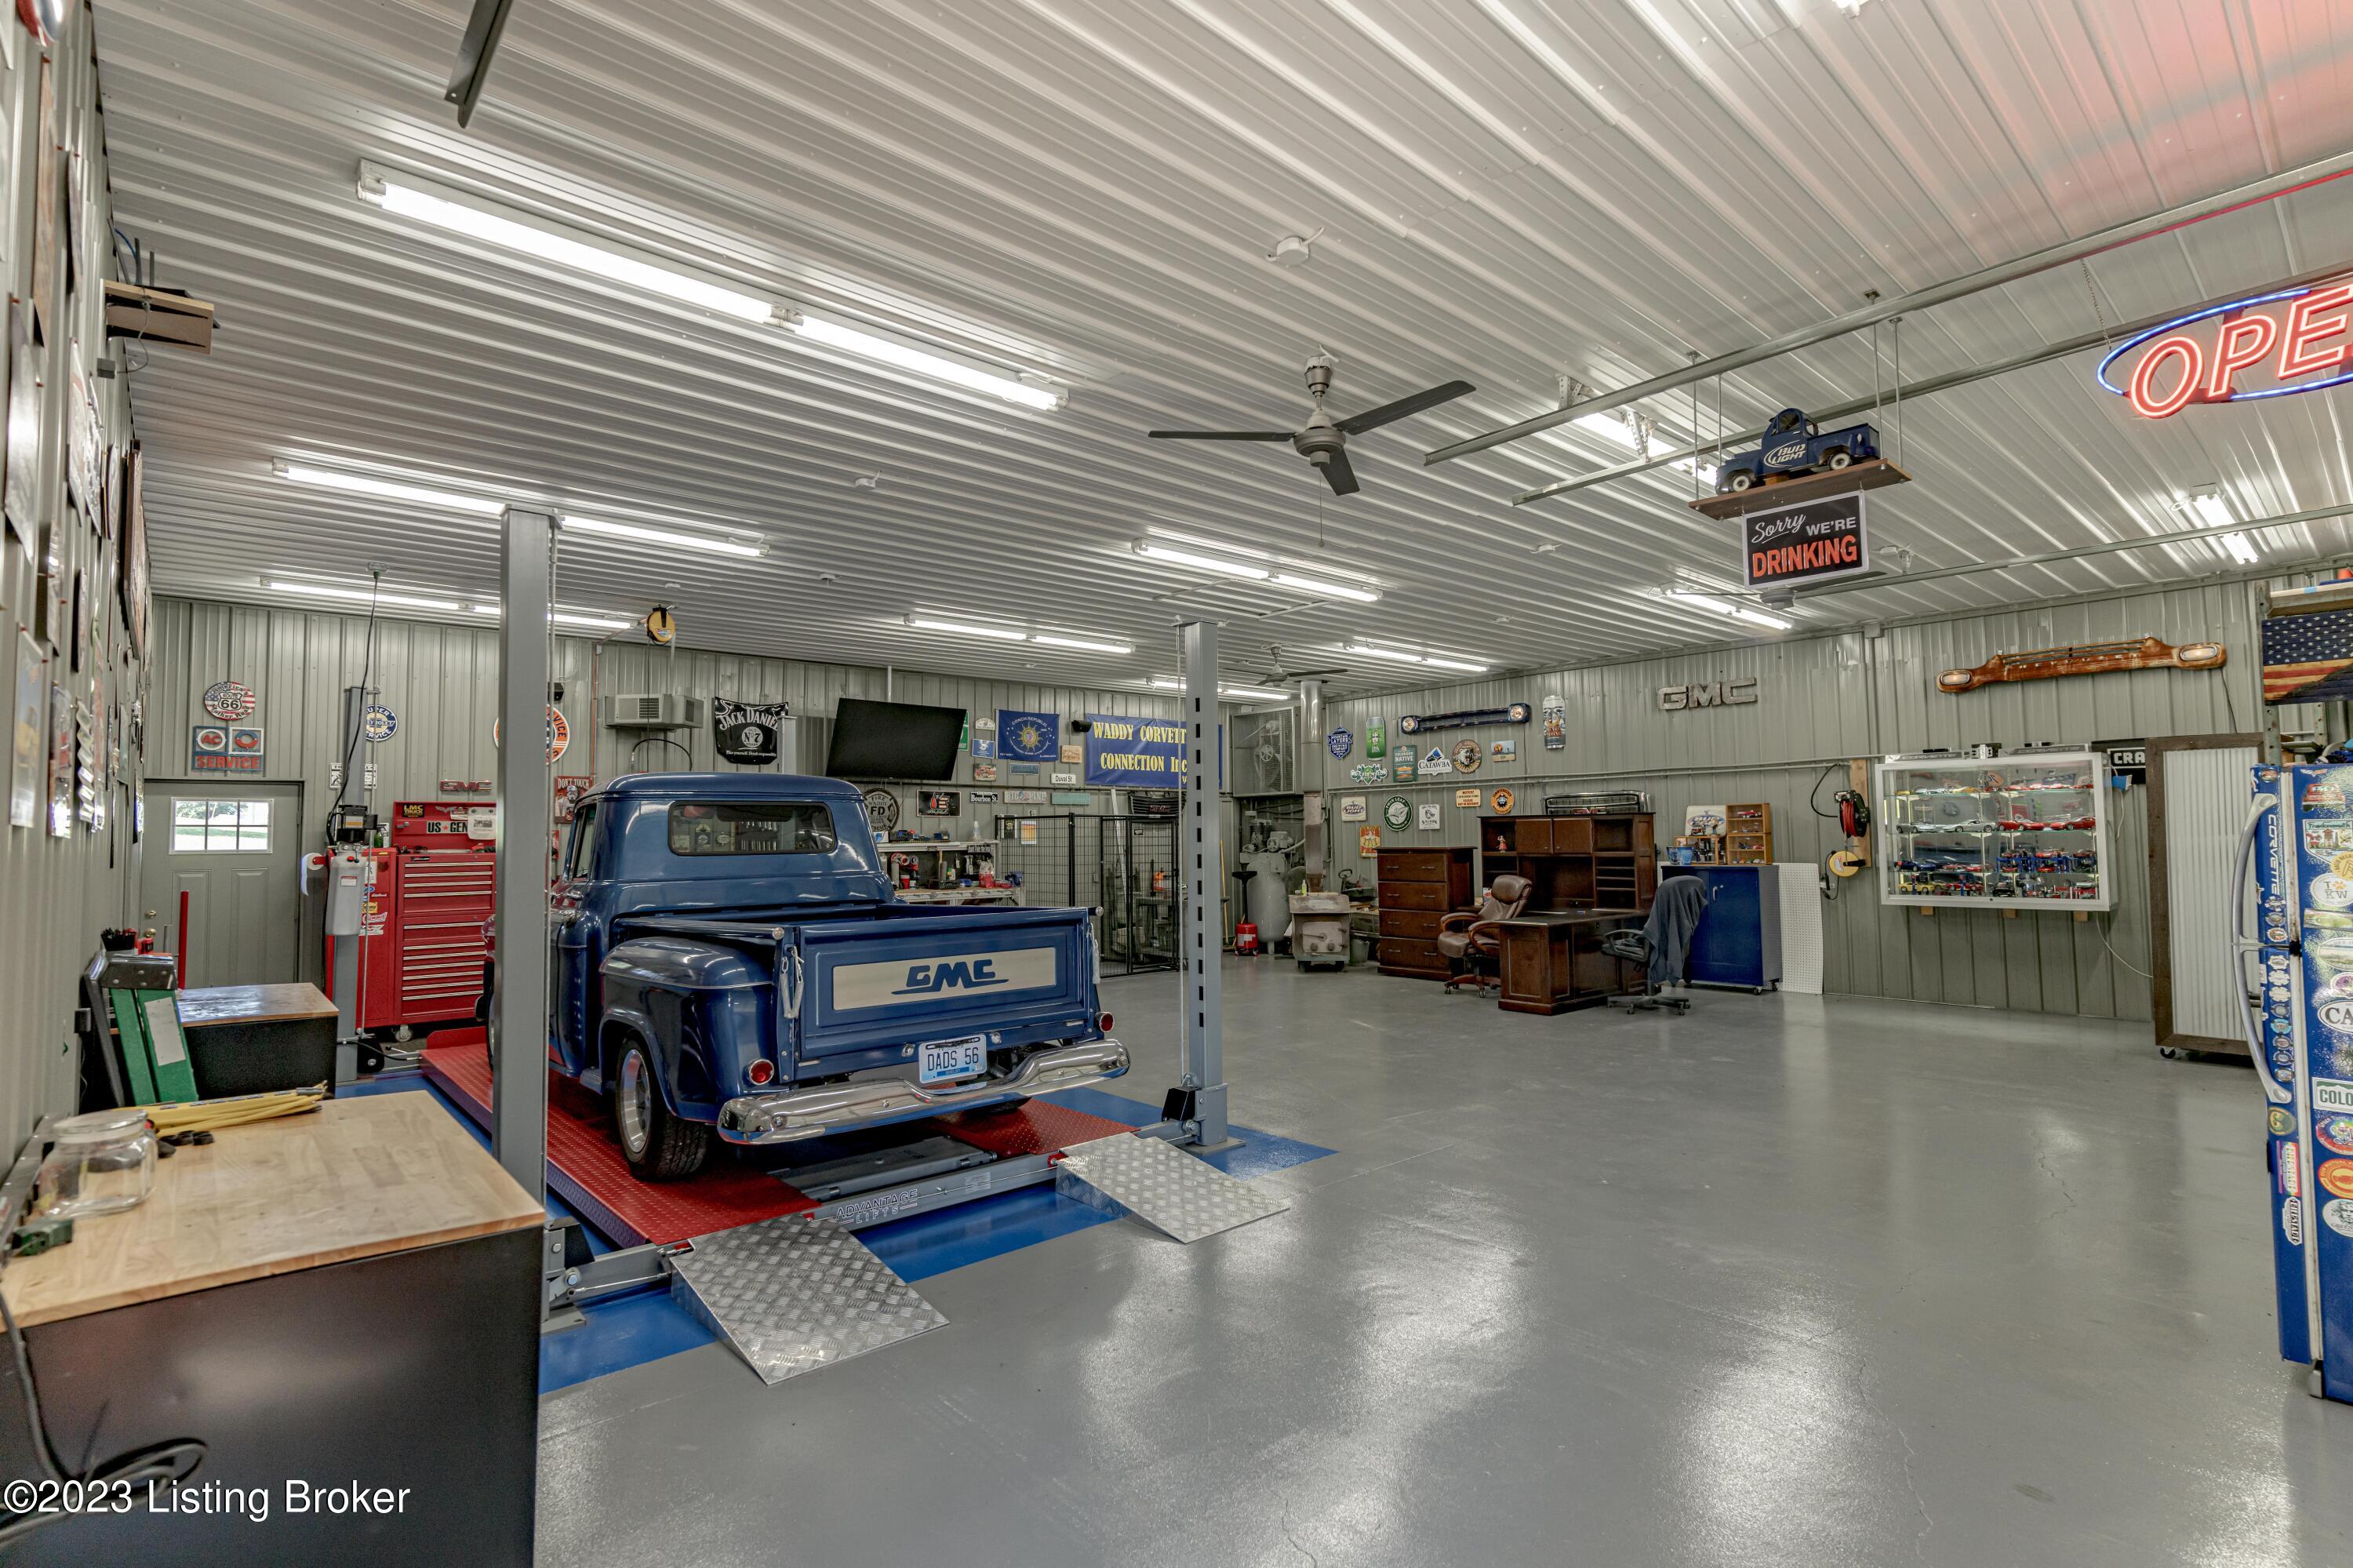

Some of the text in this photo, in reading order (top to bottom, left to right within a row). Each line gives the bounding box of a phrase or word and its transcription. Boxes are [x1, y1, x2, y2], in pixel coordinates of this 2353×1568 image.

[1778, 443, 1806, 456] BUD
[1771, 450, 1806, 464] LIGHT
[1751, 514, 1857, 544] Sorry WE'RE
[1752, 534, 1857, 578] DRINKING
[1657, 677, 1758, 710] GMC
[220, 699, 239, 709] 66
[235, 705, 250, 718] Road
[719, 711, 746, 730] JACK
[1012, 716, 1048, 727] CONCH REPUBLIC
[201, 734, 223, 744] AC
[1093, 722, 1187, 744] WADDY CORVETT
[197, 755, 260, 769] SERVICE
[1100, 752, 1165, 772] CONNECTION
[440, 780, 493, 791] GMC
[574, 779, 589, 789] TOUCH
[971, 793, 991, 802] Bourbon
[1029, 792, 1046, 801] PINE
[871, 806, 886, 815] FD
[427, 822, 441, 832] US
[2268, 814, 2280, 895] CORVETTE
[2325, 890, 2348, 899] KW
[902, 959, 998, 991] GMC
[927, 1047, 979, 1071] DADS 56
[835, 1189, 918, 1221] ADVANTAGE
[856, 1206, 899, 1224] LIFTS
